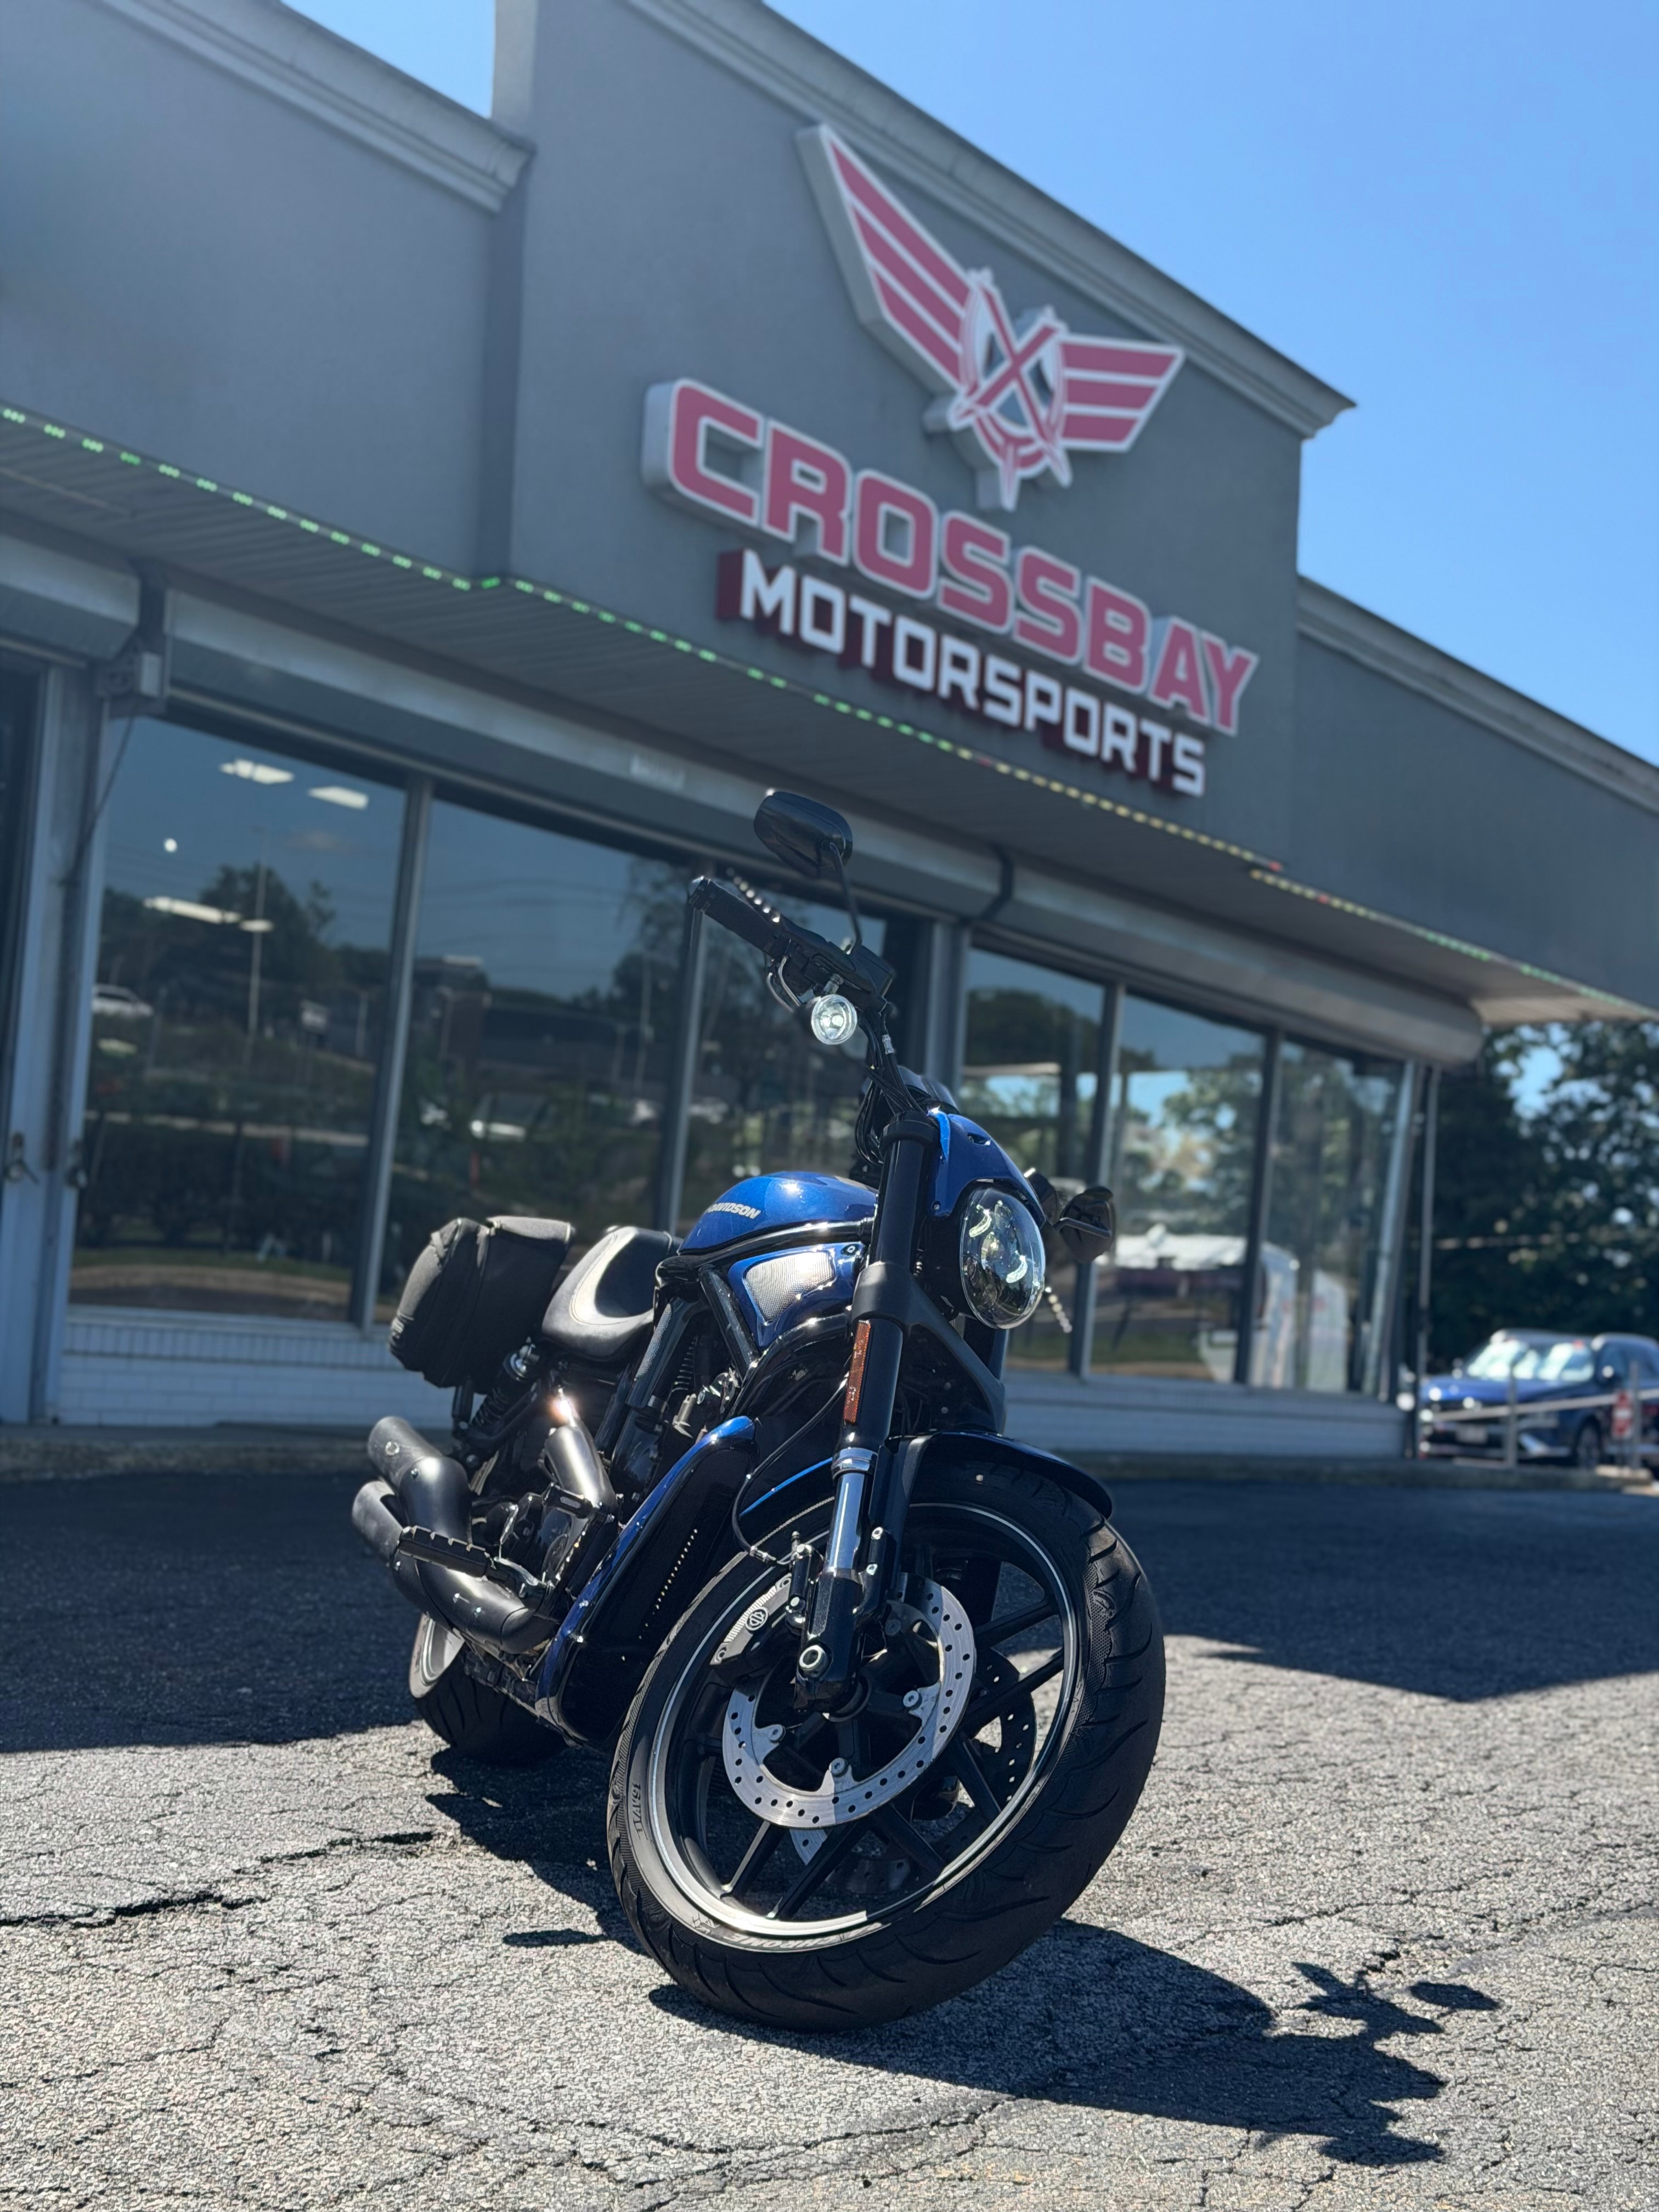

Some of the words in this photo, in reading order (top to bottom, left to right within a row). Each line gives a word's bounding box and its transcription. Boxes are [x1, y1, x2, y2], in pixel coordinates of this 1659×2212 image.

[669, 379, 1260, 736] CROSSBAY
[740, 549, 1205, 797] MOTORSPORTS
[723, 1933, 839, 1949] CHROME
